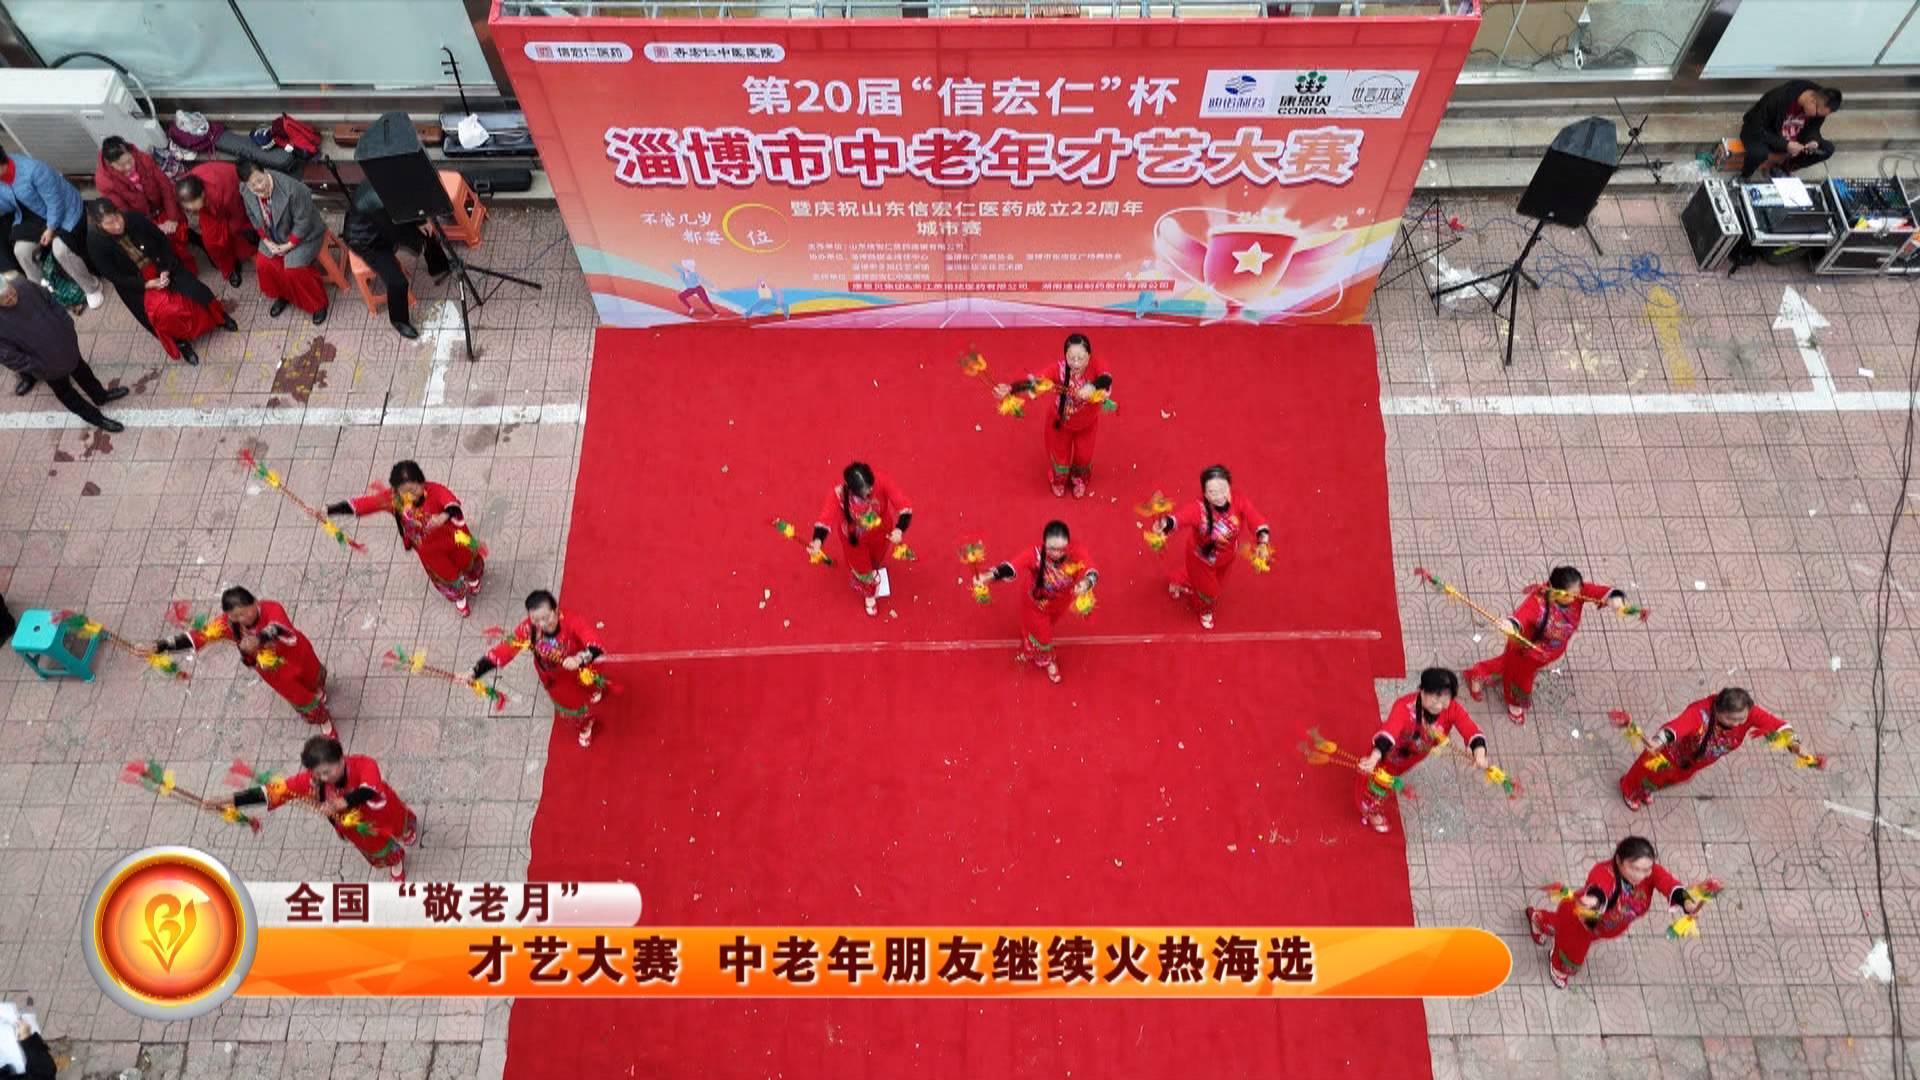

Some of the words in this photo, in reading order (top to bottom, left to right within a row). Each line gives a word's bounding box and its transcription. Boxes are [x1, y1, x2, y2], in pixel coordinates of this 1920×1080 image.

[742, 76, 1180, 117] 第20届“信宏仁”杯
[1278, 95, 1332, 107] 康恩贝
[1277, 107, 1328, 115] CONBA
[605, 126, 1364, 187] 淄博市中老年才艺大赛
[790, 200, 1144, 218] 暨庆祝山东信宏仁医药成立22周年
[916, 221, 983, 237] 城市赛
